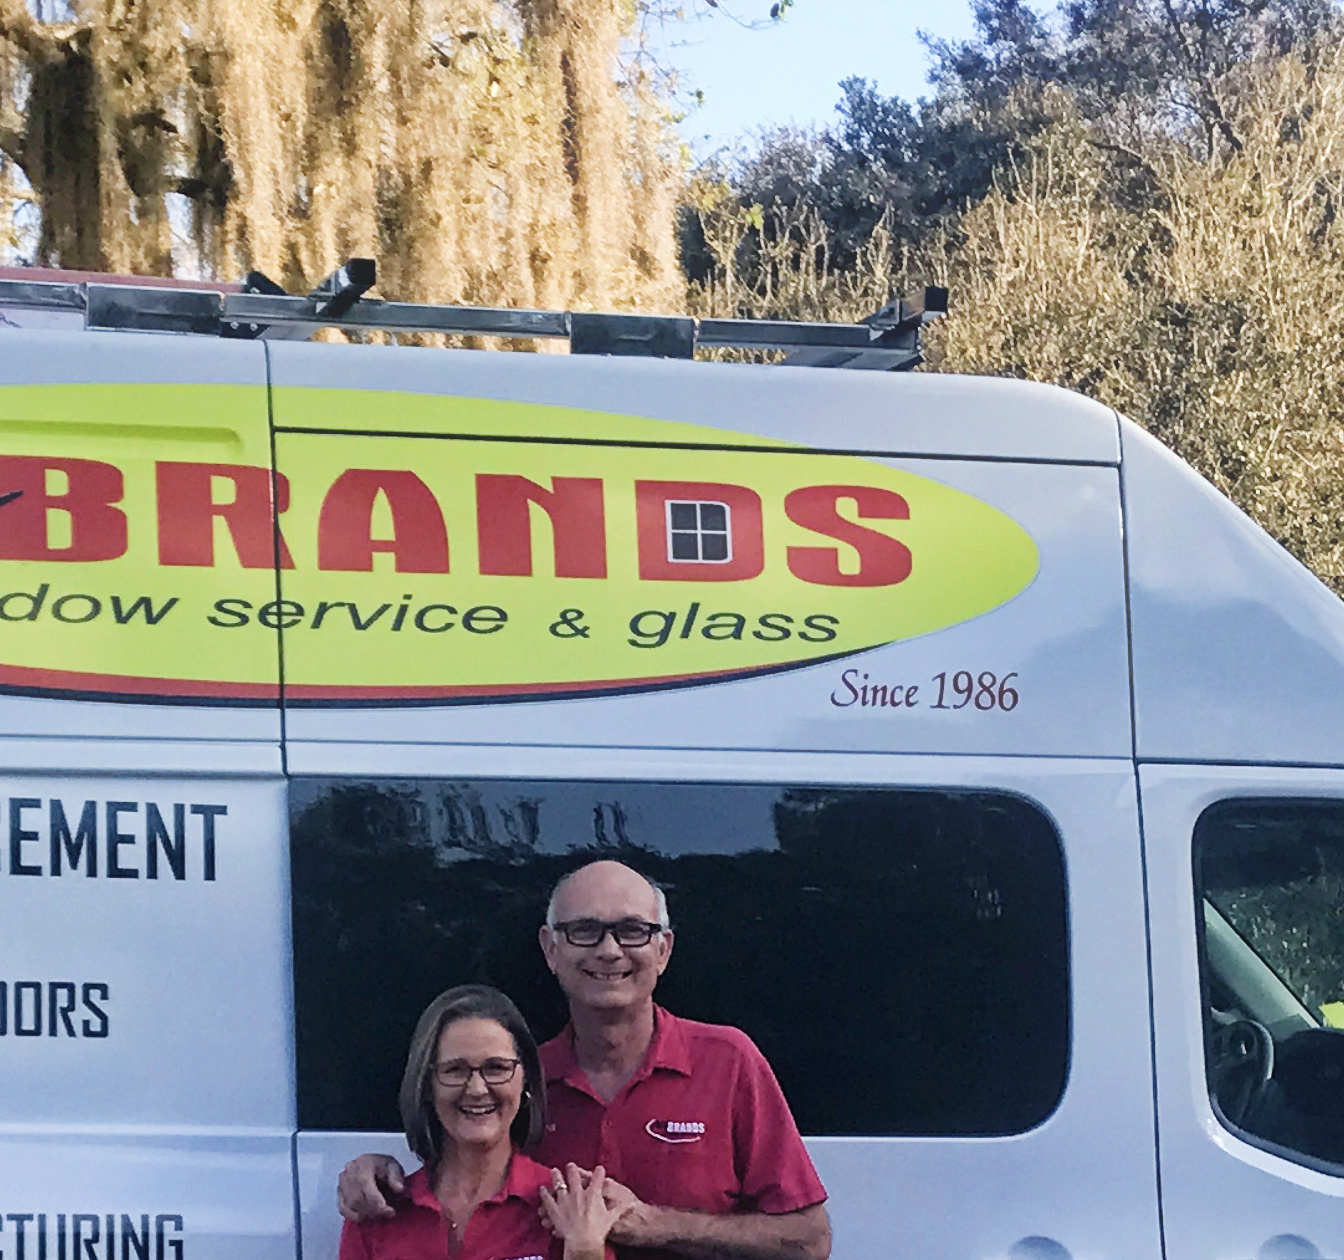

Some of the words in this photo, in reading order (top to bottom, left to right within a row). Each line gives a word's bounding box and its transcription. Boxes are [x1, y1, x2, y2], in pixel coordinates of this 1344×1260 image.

[206, 593, 509, 636] service
[548, 610, 590, 638] &
[627, 602, 841, 650] glass
[830, 668, 920, 710] Since
[929, 671, 1019, 713] 1986
